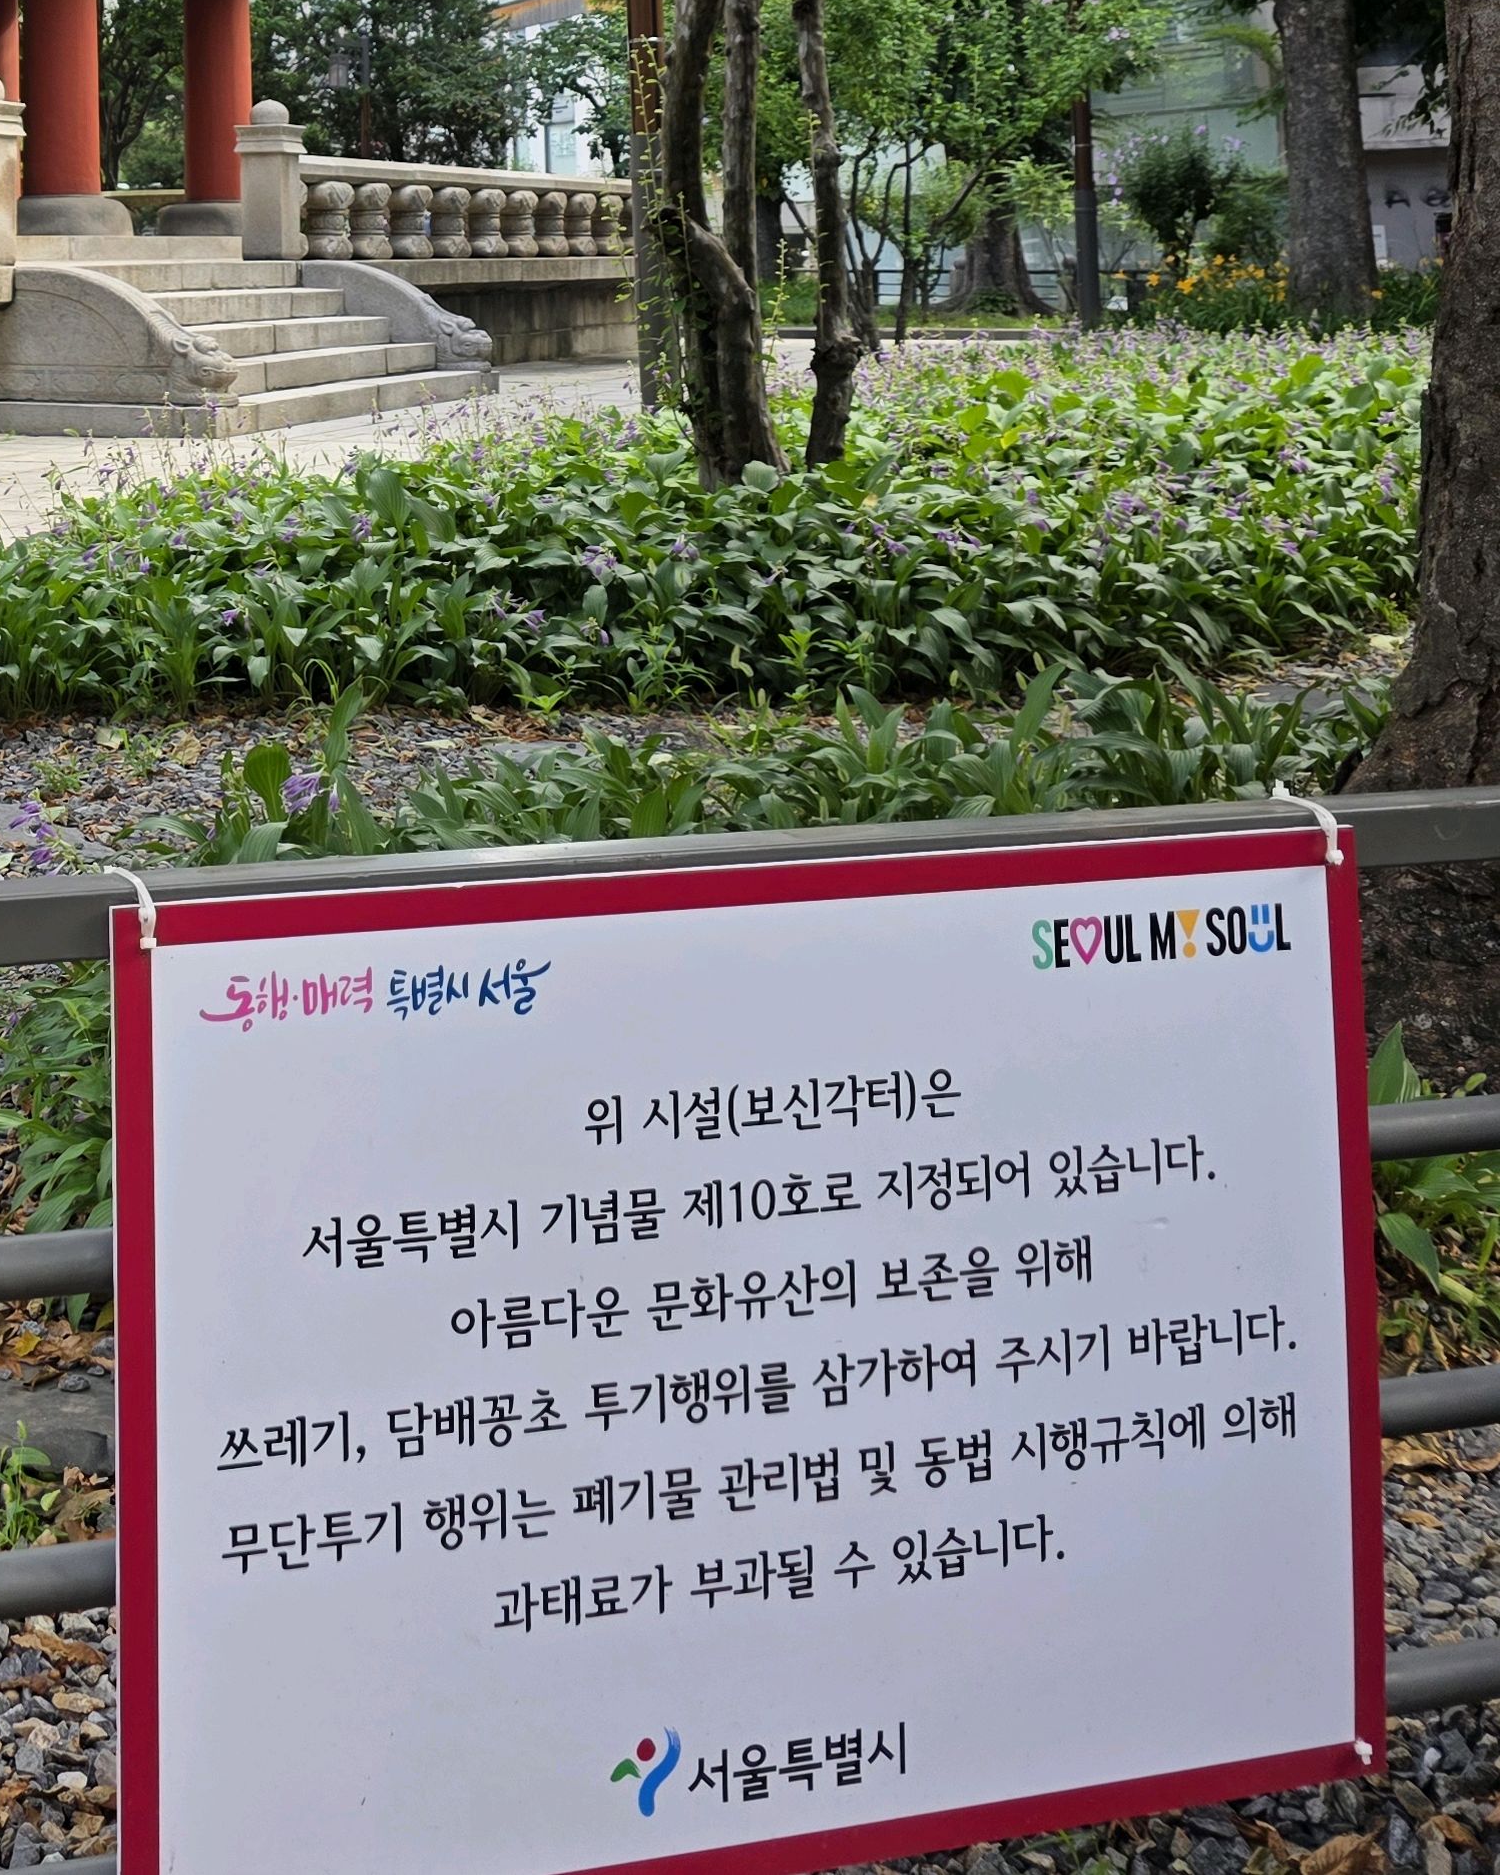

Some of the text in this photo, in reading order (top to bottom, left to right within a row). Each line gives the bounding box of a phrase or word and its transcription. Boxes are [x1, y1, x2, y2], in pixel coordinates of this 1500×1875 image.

[1205, 902, 1292, 957] SOUL
[387, 964, 469, 1021] 특별시
[478, 957, 552, 1015] 서울
[584, 1068, 962, 1146] 위 시설(보신각터)은
[302, 1134, 1217, 1270] 서울특별시 기념물 제10호로 지정되어 있습니다.
[450, 1234, 1093, 1350] 아름다운 문화유산의 보존을 위해
[216, 1304, 1298, 1472] 쓰레기, 담배꽁초 투기행위를 삼가하여 주시기 바랍니다.
[221, 1391, 1297, 1575] 무단투기 행위는 폐기물 관리법 및 동법 시행규칙에 의해
[493, 1513, 1066, 1634] 과태료가 부과될 수 있습니다.
[687, 1721, 908, 1804] 서울특별시
